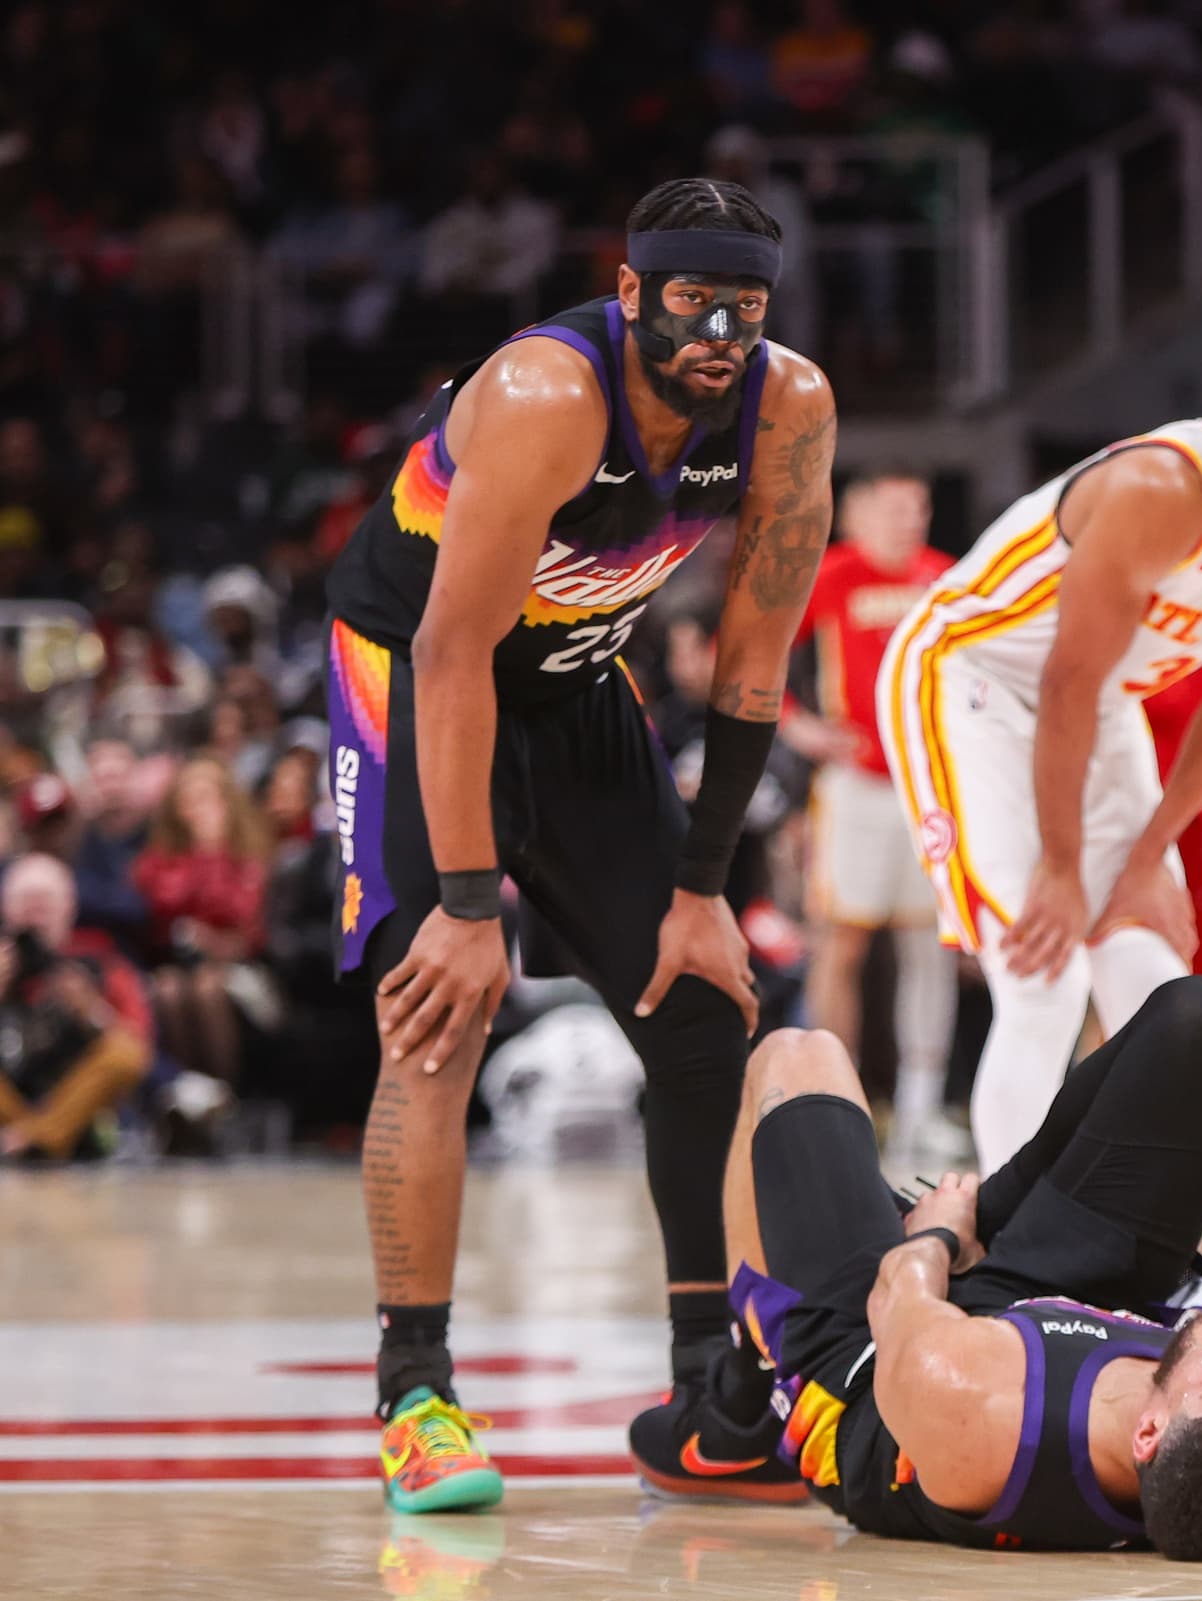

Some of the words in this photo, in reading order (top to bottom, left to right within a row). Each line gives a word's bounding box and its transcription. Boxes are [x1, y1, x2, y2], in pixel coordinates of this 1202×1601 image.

[679, 462, 738, 487] PayPal
[538, 603, 648, 673] 23
[1123, 655, 1196, 697] 3
[1041, 1320, 1109, 1341] PayPal
